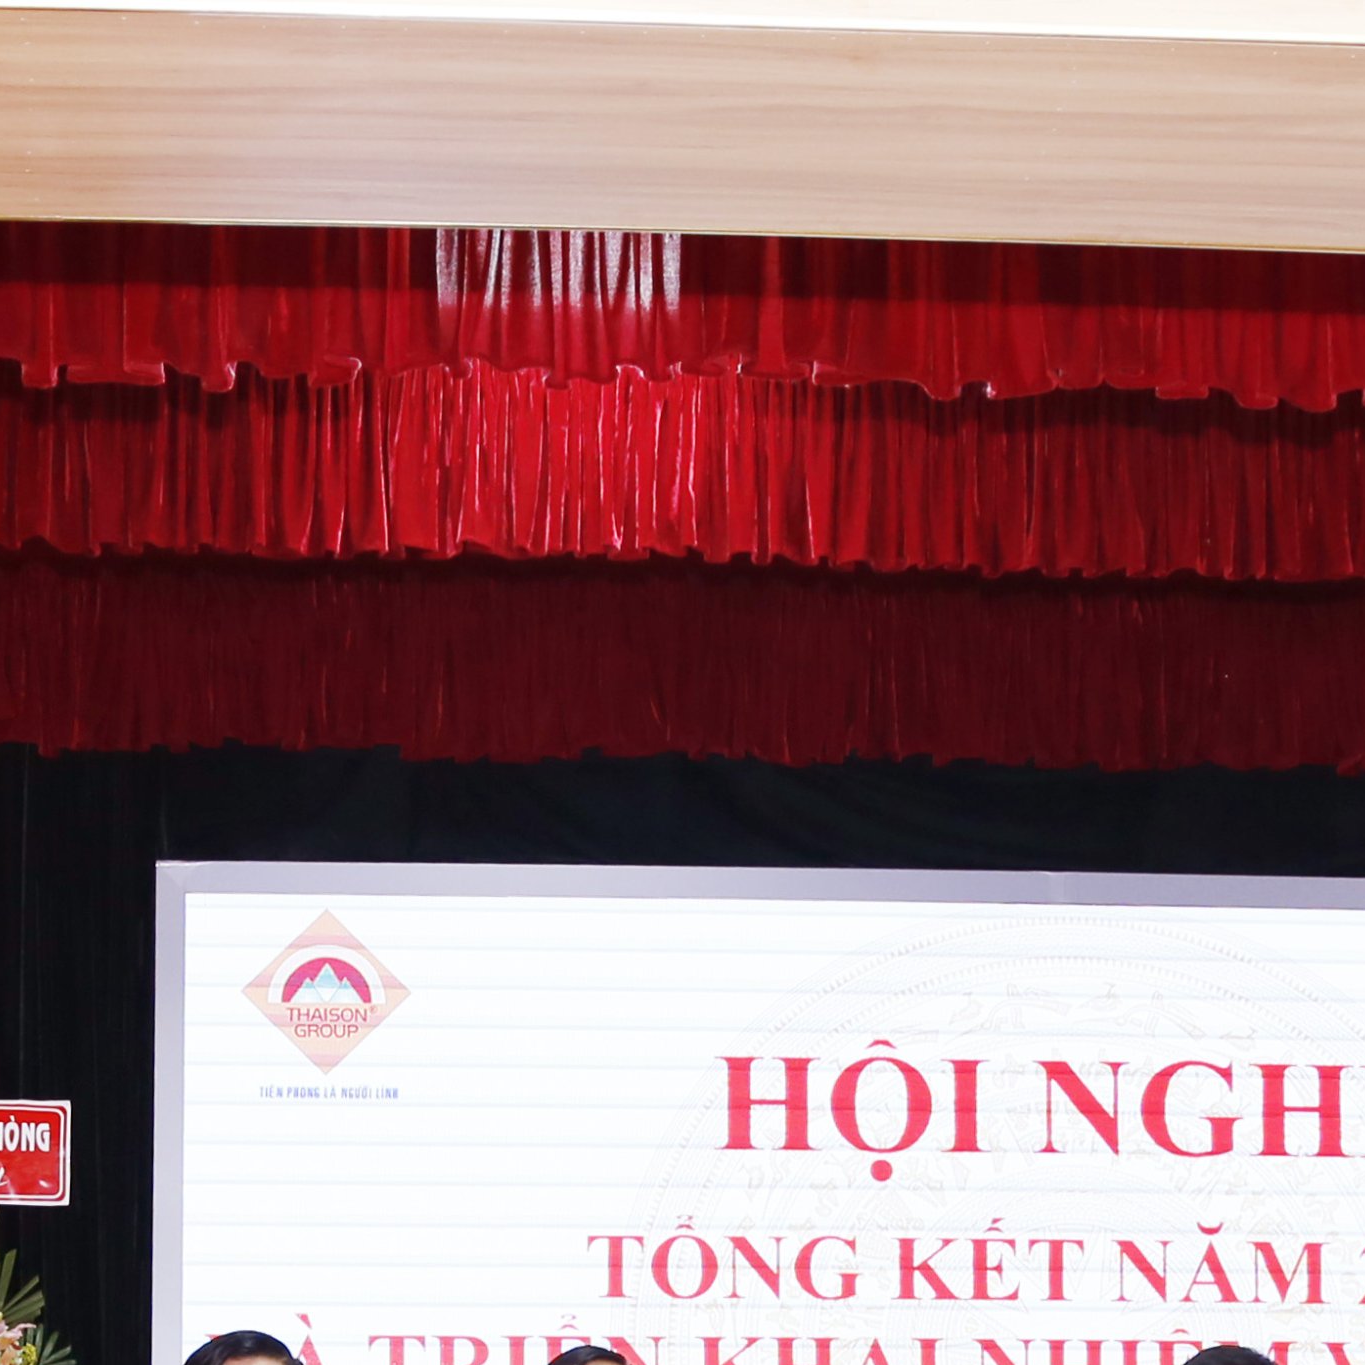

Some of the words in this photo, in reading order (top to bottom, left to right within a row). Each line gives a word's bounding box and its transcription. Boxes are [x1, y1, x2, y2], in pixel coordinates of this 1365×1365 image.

[286, 1007, 368, 1023] THAISON
[294, 1023, 359, 1039] GROUP
[714, 1039, 990, 1182] HỘI
[586, 1213, 861, 1303] TỔNG
[890, 1216, 1085, 1304] KẾT
[1115, 1220, 1335, 1306] NĂM
